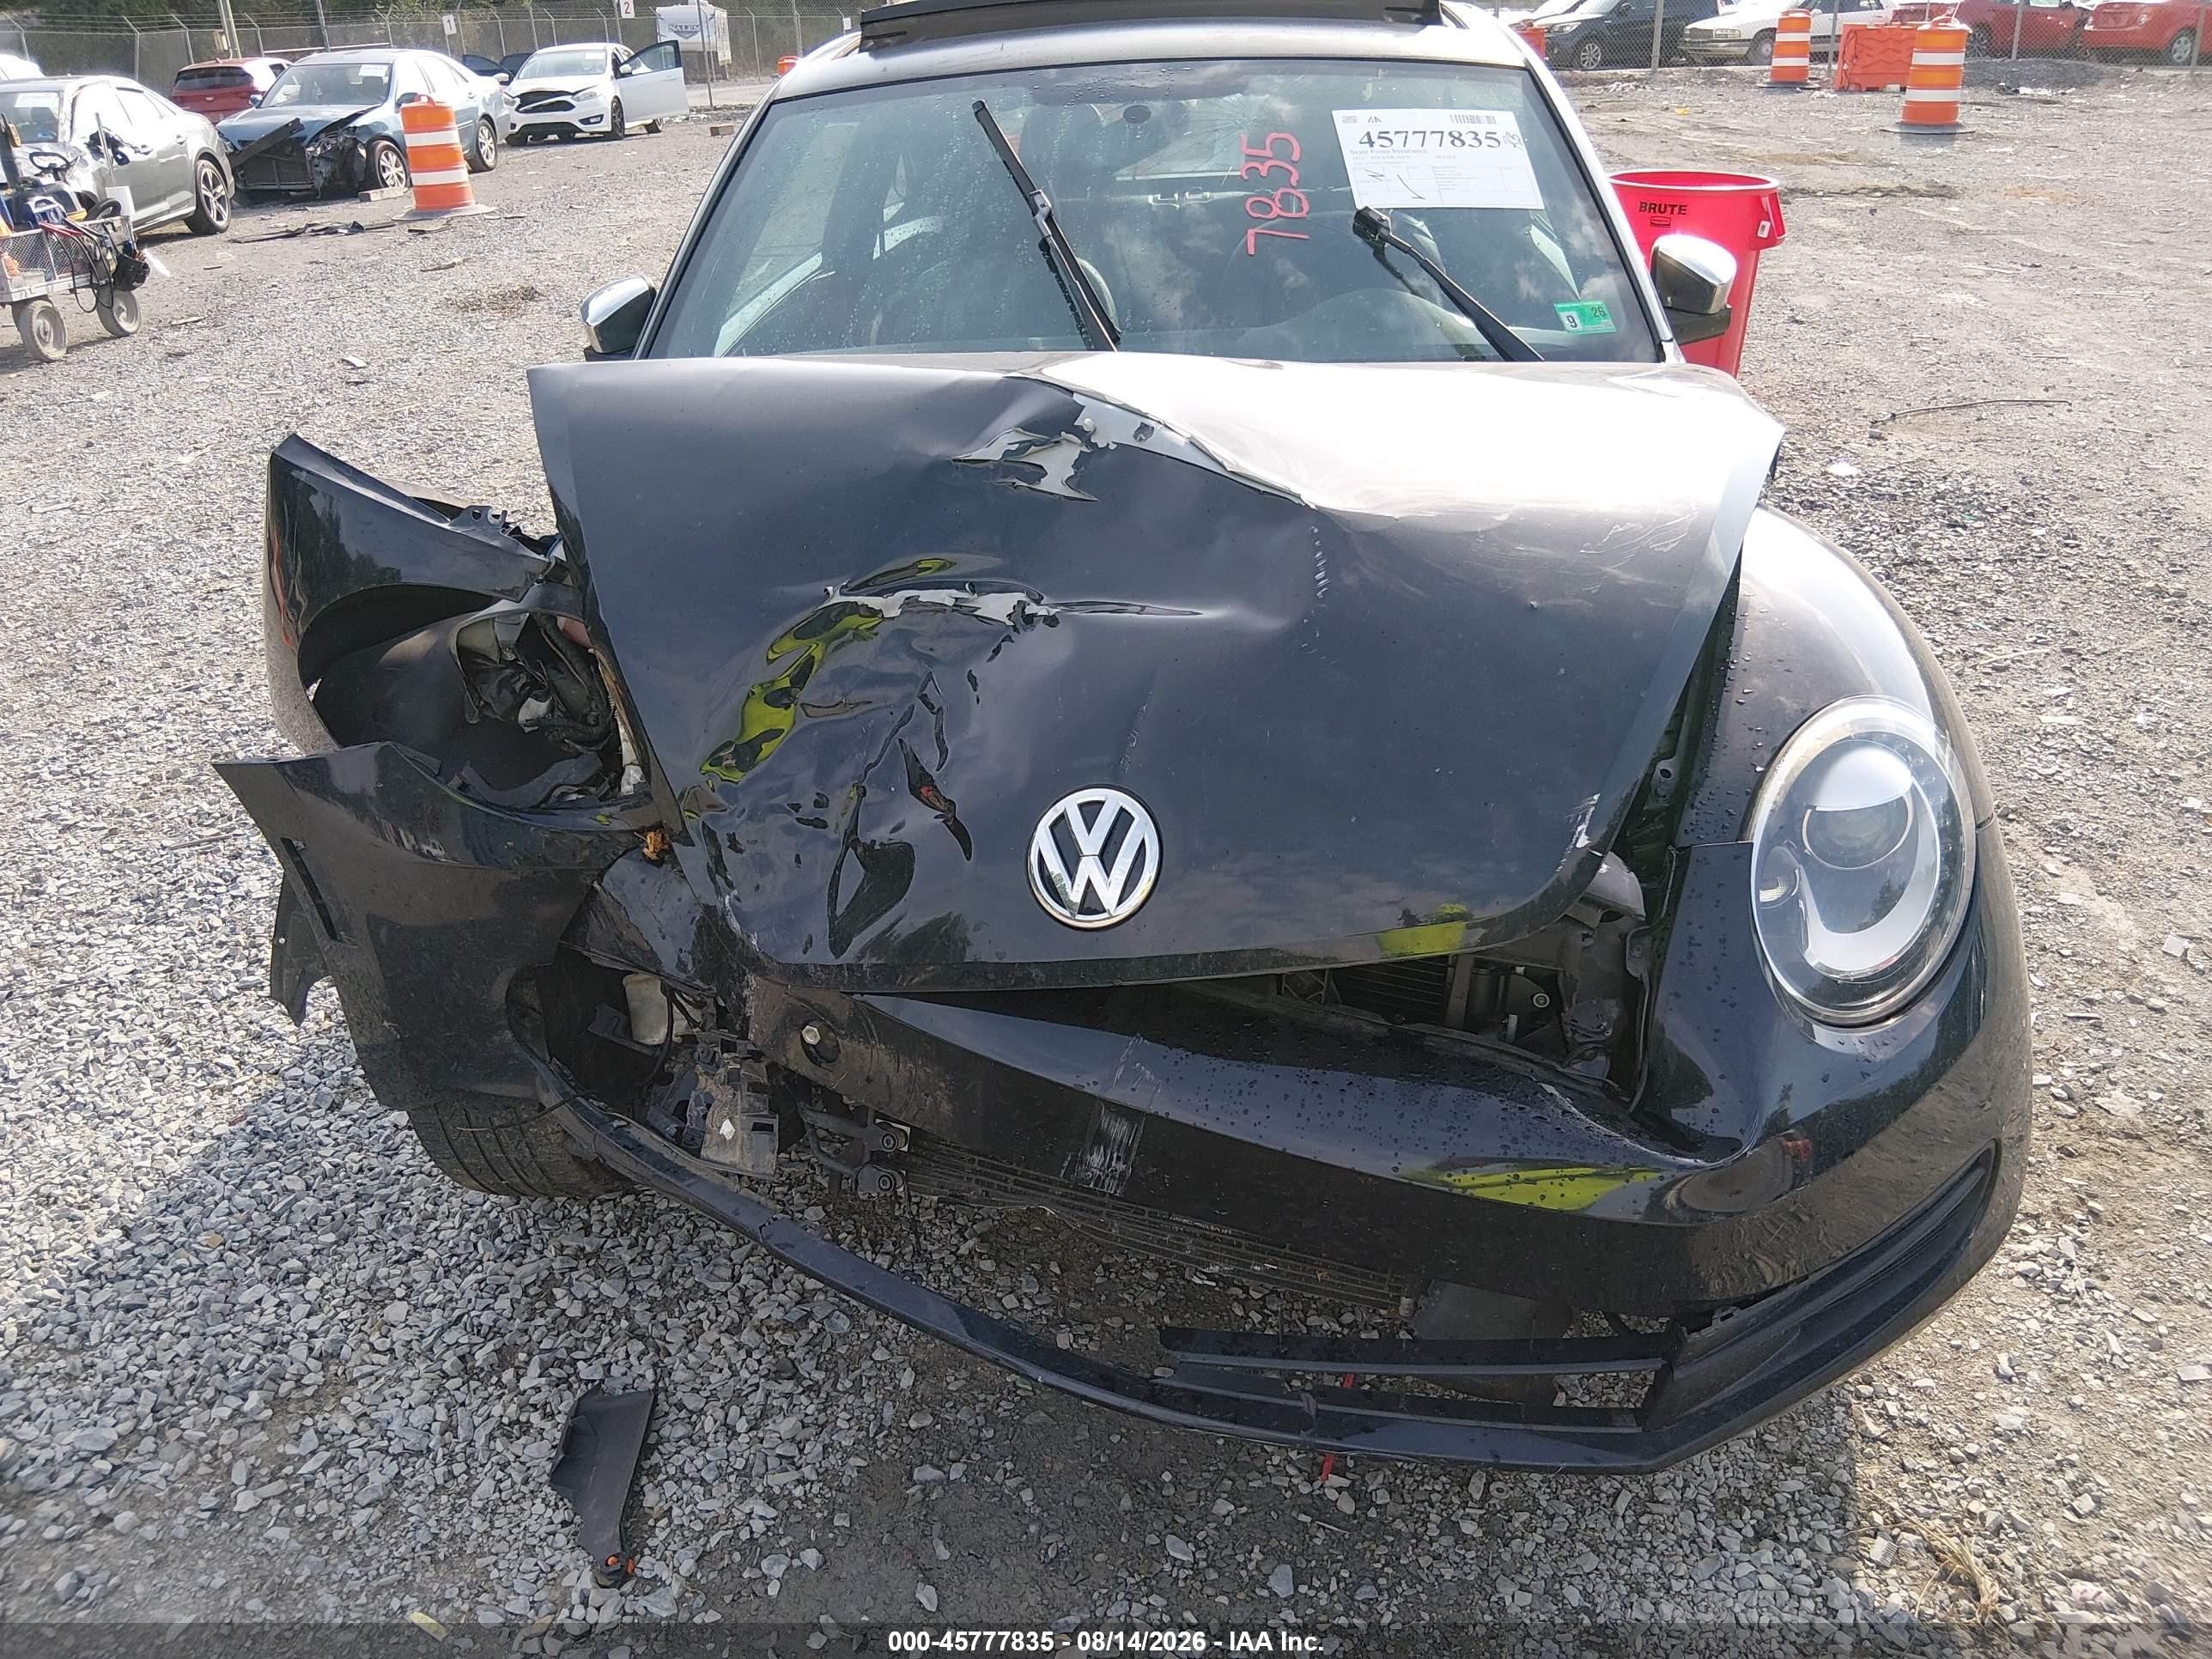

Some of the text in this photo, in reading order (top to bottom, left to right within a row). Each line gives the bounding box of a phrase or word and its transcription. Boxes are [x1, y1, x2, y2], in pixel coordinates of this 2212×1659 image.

[624, 2, 630, 15] 2
[446, 19, 453, 31] 1
[1358, 130, 1501, 149] 45777835
[1240, 132, 1310, 256] 7835
[1638, 202, 1687, 215] BRUTE
[1566, 306, 1606, 328] 9 26
